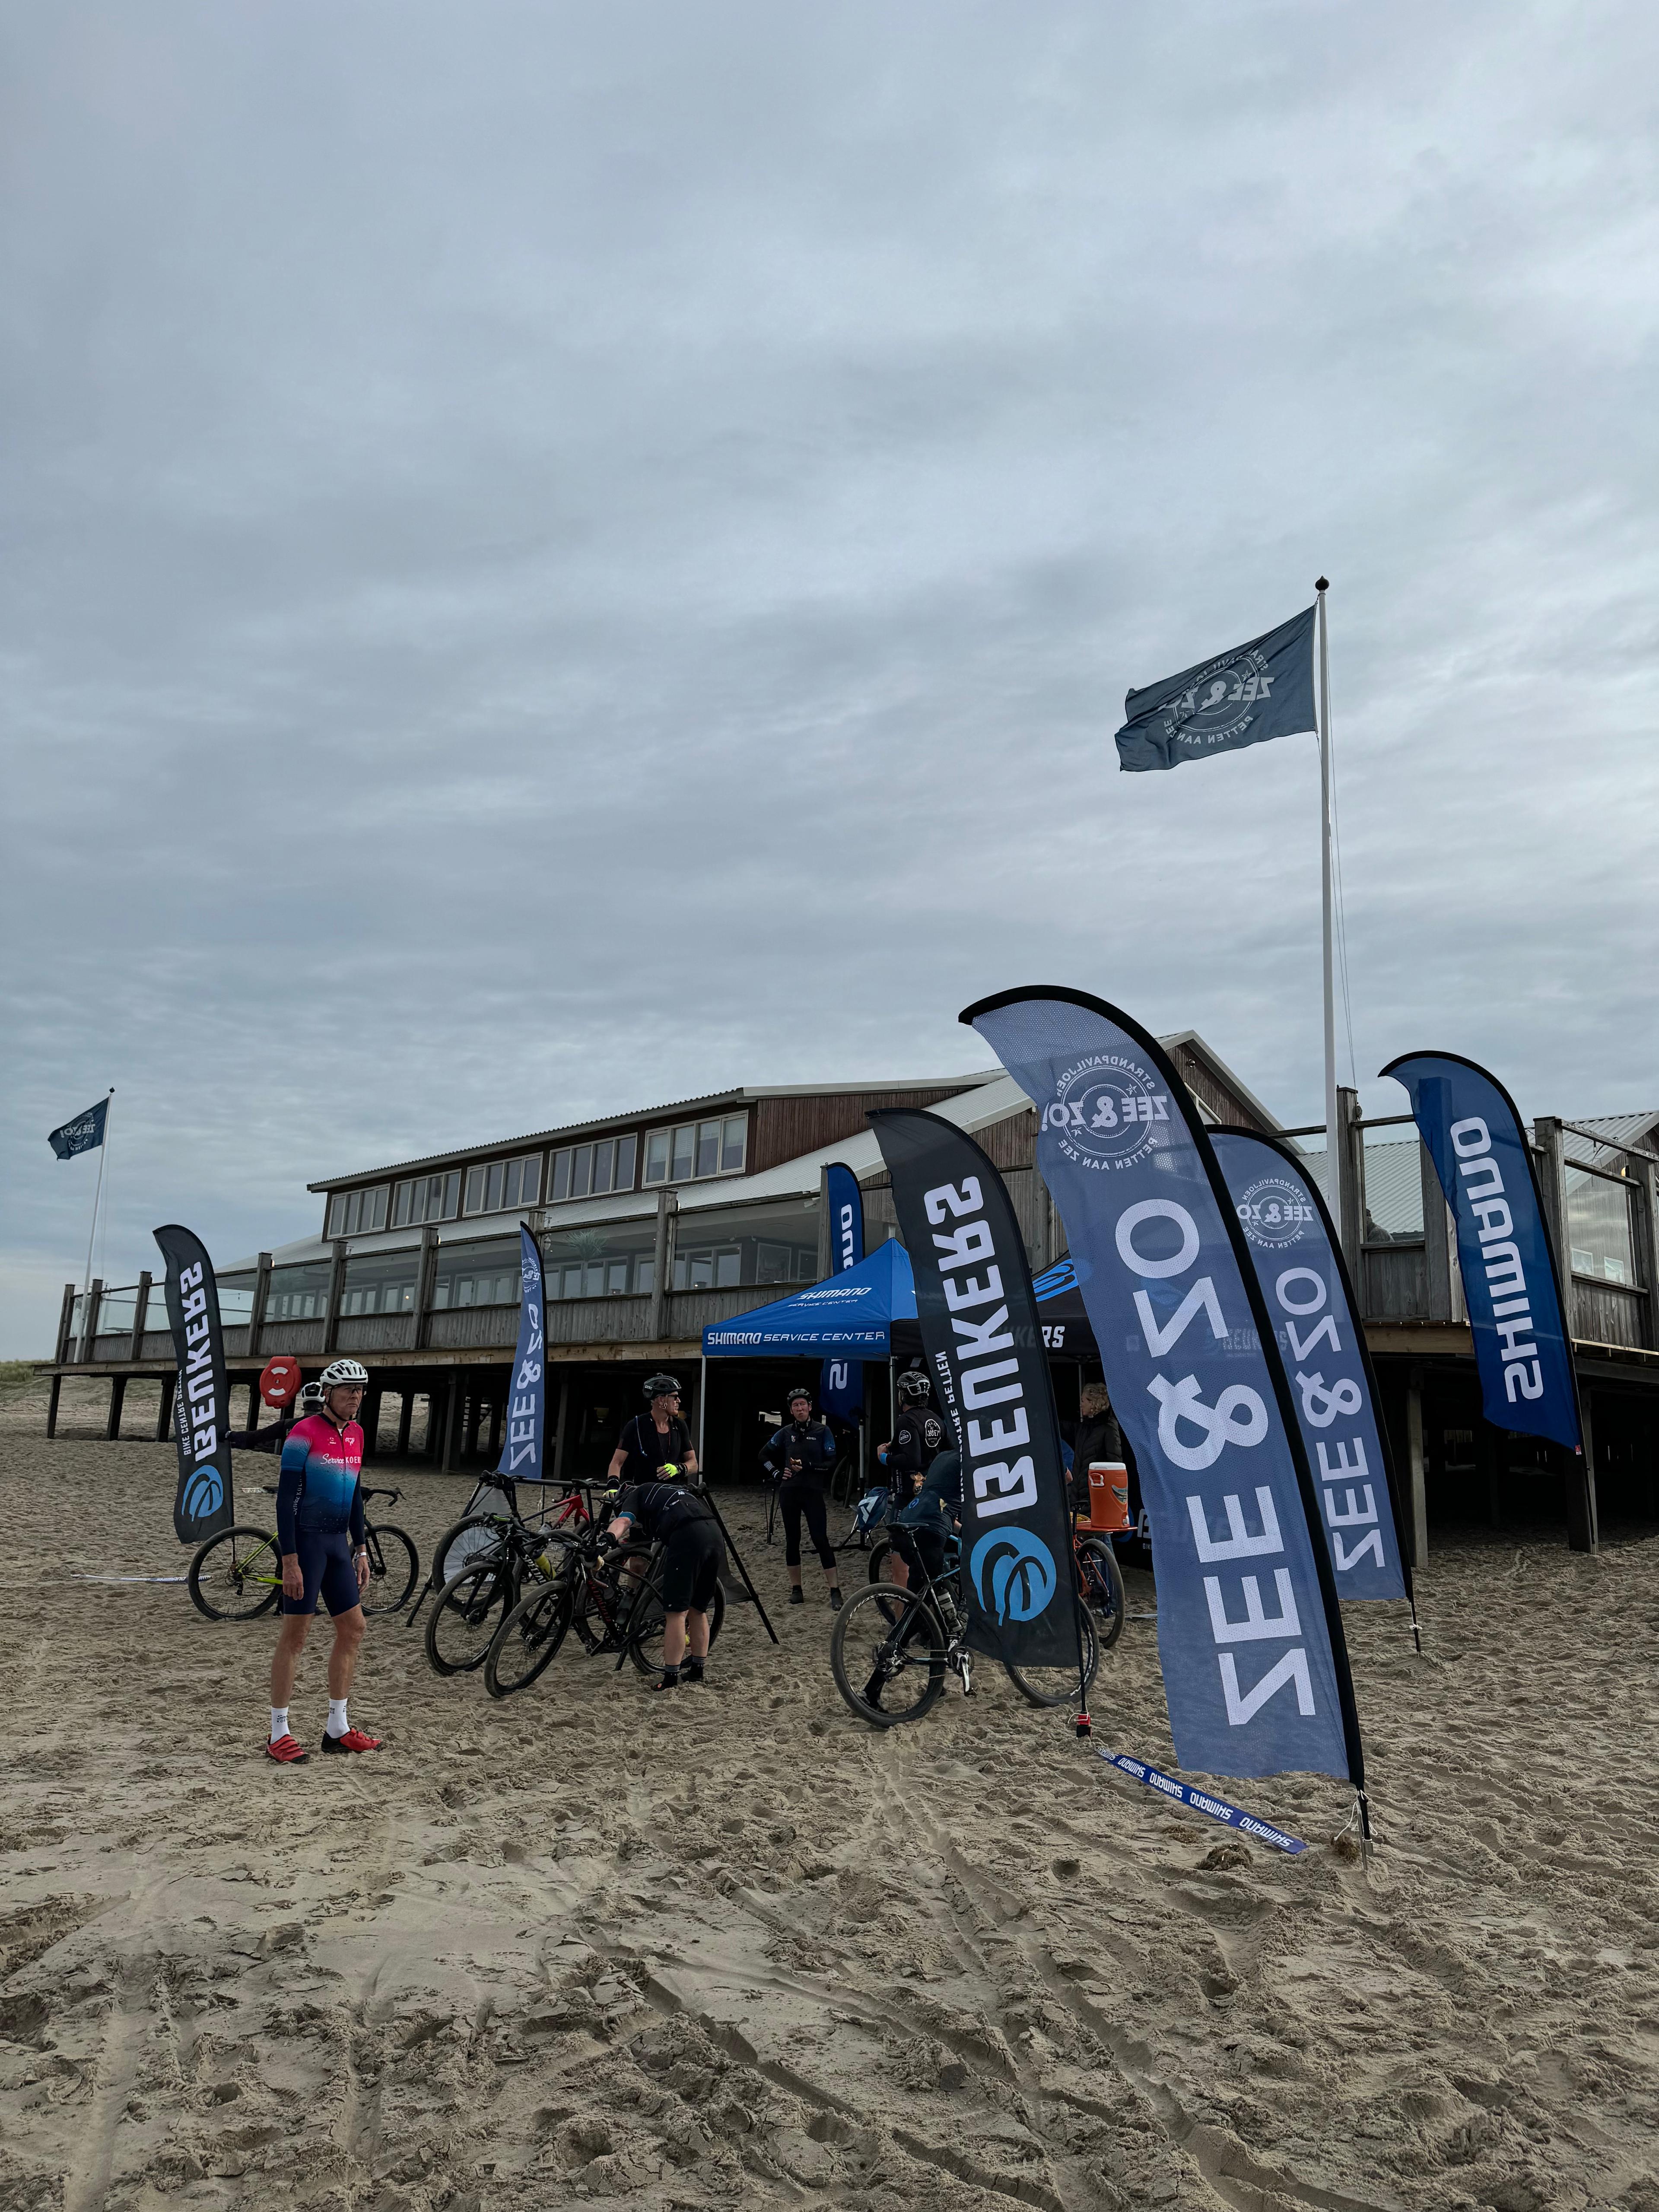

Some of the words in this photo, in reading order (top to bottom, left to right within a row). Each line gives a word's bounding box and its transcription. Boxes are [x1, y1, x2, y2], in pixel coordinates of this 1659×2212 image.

[797, 1287, 872, 1300] SHIMANO
[708, 1332, 762, 1345] SHIMANO
[763, 1333, 819, 1341] SERVICE
[822, 1331, 885, 1341] CENTER
[321, 1453, 344, 1465] Service
[1118, 1757, 1146, 1778] SHIMANO
[1149, 1772, 1183, 1799] SHIMANO
[1189, 1792, 1233, 1820] SHIMANO
[1239, 1817, 1294, 1848] SHIMANO
